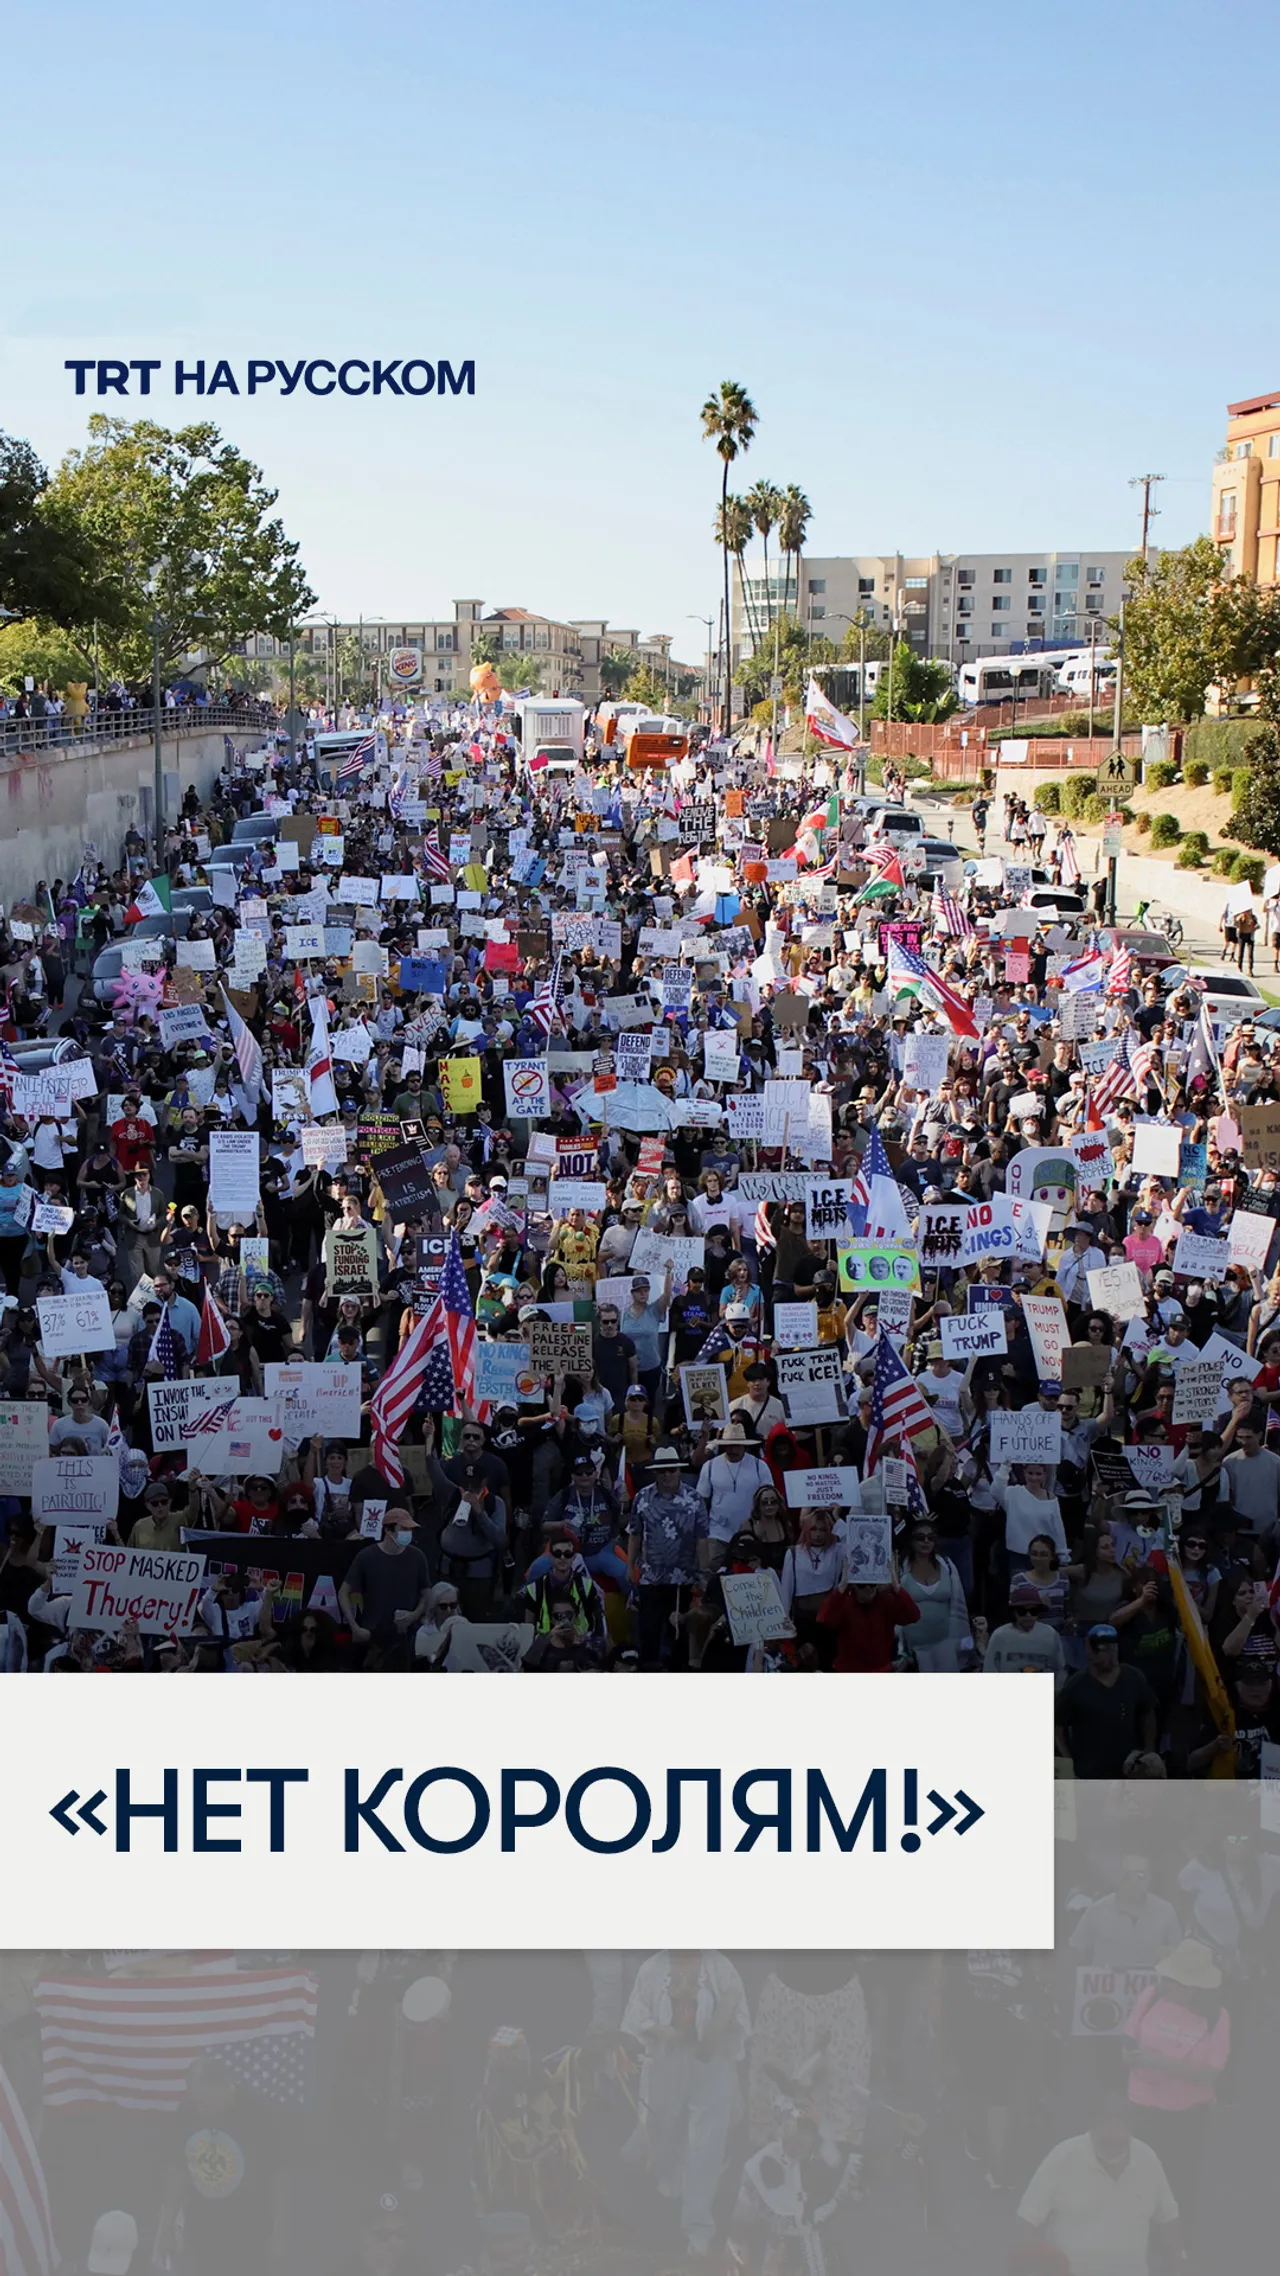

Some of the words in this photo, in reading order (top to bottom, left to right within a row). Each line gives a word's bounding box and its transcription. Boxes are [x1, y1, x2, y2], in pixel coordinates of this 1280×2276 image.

[1100, 785, 1131, 793] AHEAD
[680, 805, 714, 818] REMOVE
[682, 817, 712, 829] THE
[299, 938, 318, 947] ICE
[907, 933, 917, 942] IN
[665, 969, 691, 980] DEFEND
[621, 1035, 651, 1048] DEFEND
[505, 1062, 546, 1071] TYRANT
[1084, 1058, 1105, 1076] ICE
[15, 1077, 72, 1095] ANTI-FASCIST
[512, 1097, 524, 1105] AT
[530, 1097, 545, 1105] THE
[25, 1102, 56, 1114] DEATH
[516, 1106, 544, 1115] GATE
[1082, 1136, 1099, 1145] THE
[376, 1157, 423, 1179] PRETENDING
[560, 1153, 594, 1174] NOT
[1078, 1164, 1114, 1182] STOPPED
[403, 1182, 416, 1194] IS
[386, 1189, 432, 1211] PATRIOTISM
[811, 1207, 848, 1224] MELTS
[967, 1205, 992, 1229] NO
[334, 1245, 356, 1255] STOP
[923, 1236, 962, 1252] MELTS
[334, 1256, 369, 1264] FUNDING
[334, 1265, 368, 1275] ISRAEL
[1099, 1271, 1121, 1287] YES
[880, 1306, 889, 1315] NO
[890, 1307, 909, 1316] KINGS
[1027, 1303, 1059, 1316] TRUMP
[43, 1312, 67, 1334] 37%
[533, 1323, 568, 1332] FREE
[948, 1315, 989, 1333] FUCK
[1034, 1323, 1060, 1334] MUST
[533, 1334, 591, 1346] PALESTINE
[952, 1332, 1002, 1352] TRUMP
[1044, 1340, 1058, 1350] GO
[479, 1344, 496, 1358] NO
[533, 1346, 586, 1358] RELEASE
[532, 1360, 555, 1371] THE
[560, 1359, 592, 1372] FILES
[781, 1357, 806, 1369] FUCK
[810, 1353, 838, 1366] TRUMP
[1220, 1349, 1242, 1370] NO
[1183, 1366, 1197, 1375] THE
[1198, 1361, 1225, 1374] POWER
[781, 1371, 805, 1384] FUCK
[809, 1366, 841, 1383] ICE!
[1198, 1373, 1222, 1384] PEOPLE
[701, 1381, 716, 1389] REY
[1175, 1389, 1184, 1397] IS
[1185, 1385, 1222, 1398] STRONGER
[152, 1386, 188, 1407] INVOKE
[191, 1385, 206, 1397] THE
[259, 1416, 273, 1424] THIS
[992, 1413, 1032, 1426] HANDS
[1034, 1413, 1055, 1424] OFF
[1187, 1408, 1214, 1419] POWER
[155, 1426, 176, 1443] ON
[1015, 1426, 1034, 1437] MY
[999, 1436, 1053, 1451] FUTURE
[1137, 1446, 1161, 1459] NO
[56, 1460, 93, 1476] THIS
[1129, 1458, 1163, 1467] KINGS
[64, 1479, 76, 1490] IS
[42, 1490, 107, 1510] PATRIOTIC!
[808, 1493, 844, 1501] FREEDOM
[84, 1551, 126, 1573] STOP
[130, 1555, 201, 1583] MASKED
[724, 1580, 756, 1593] Come
[744, 1591, 763, 1602] the
[84, 1580, 200, 1630] Thugery!
[730, 1605, 782, 1621] Children
[1083, 1973, 1115, 1994] NO
